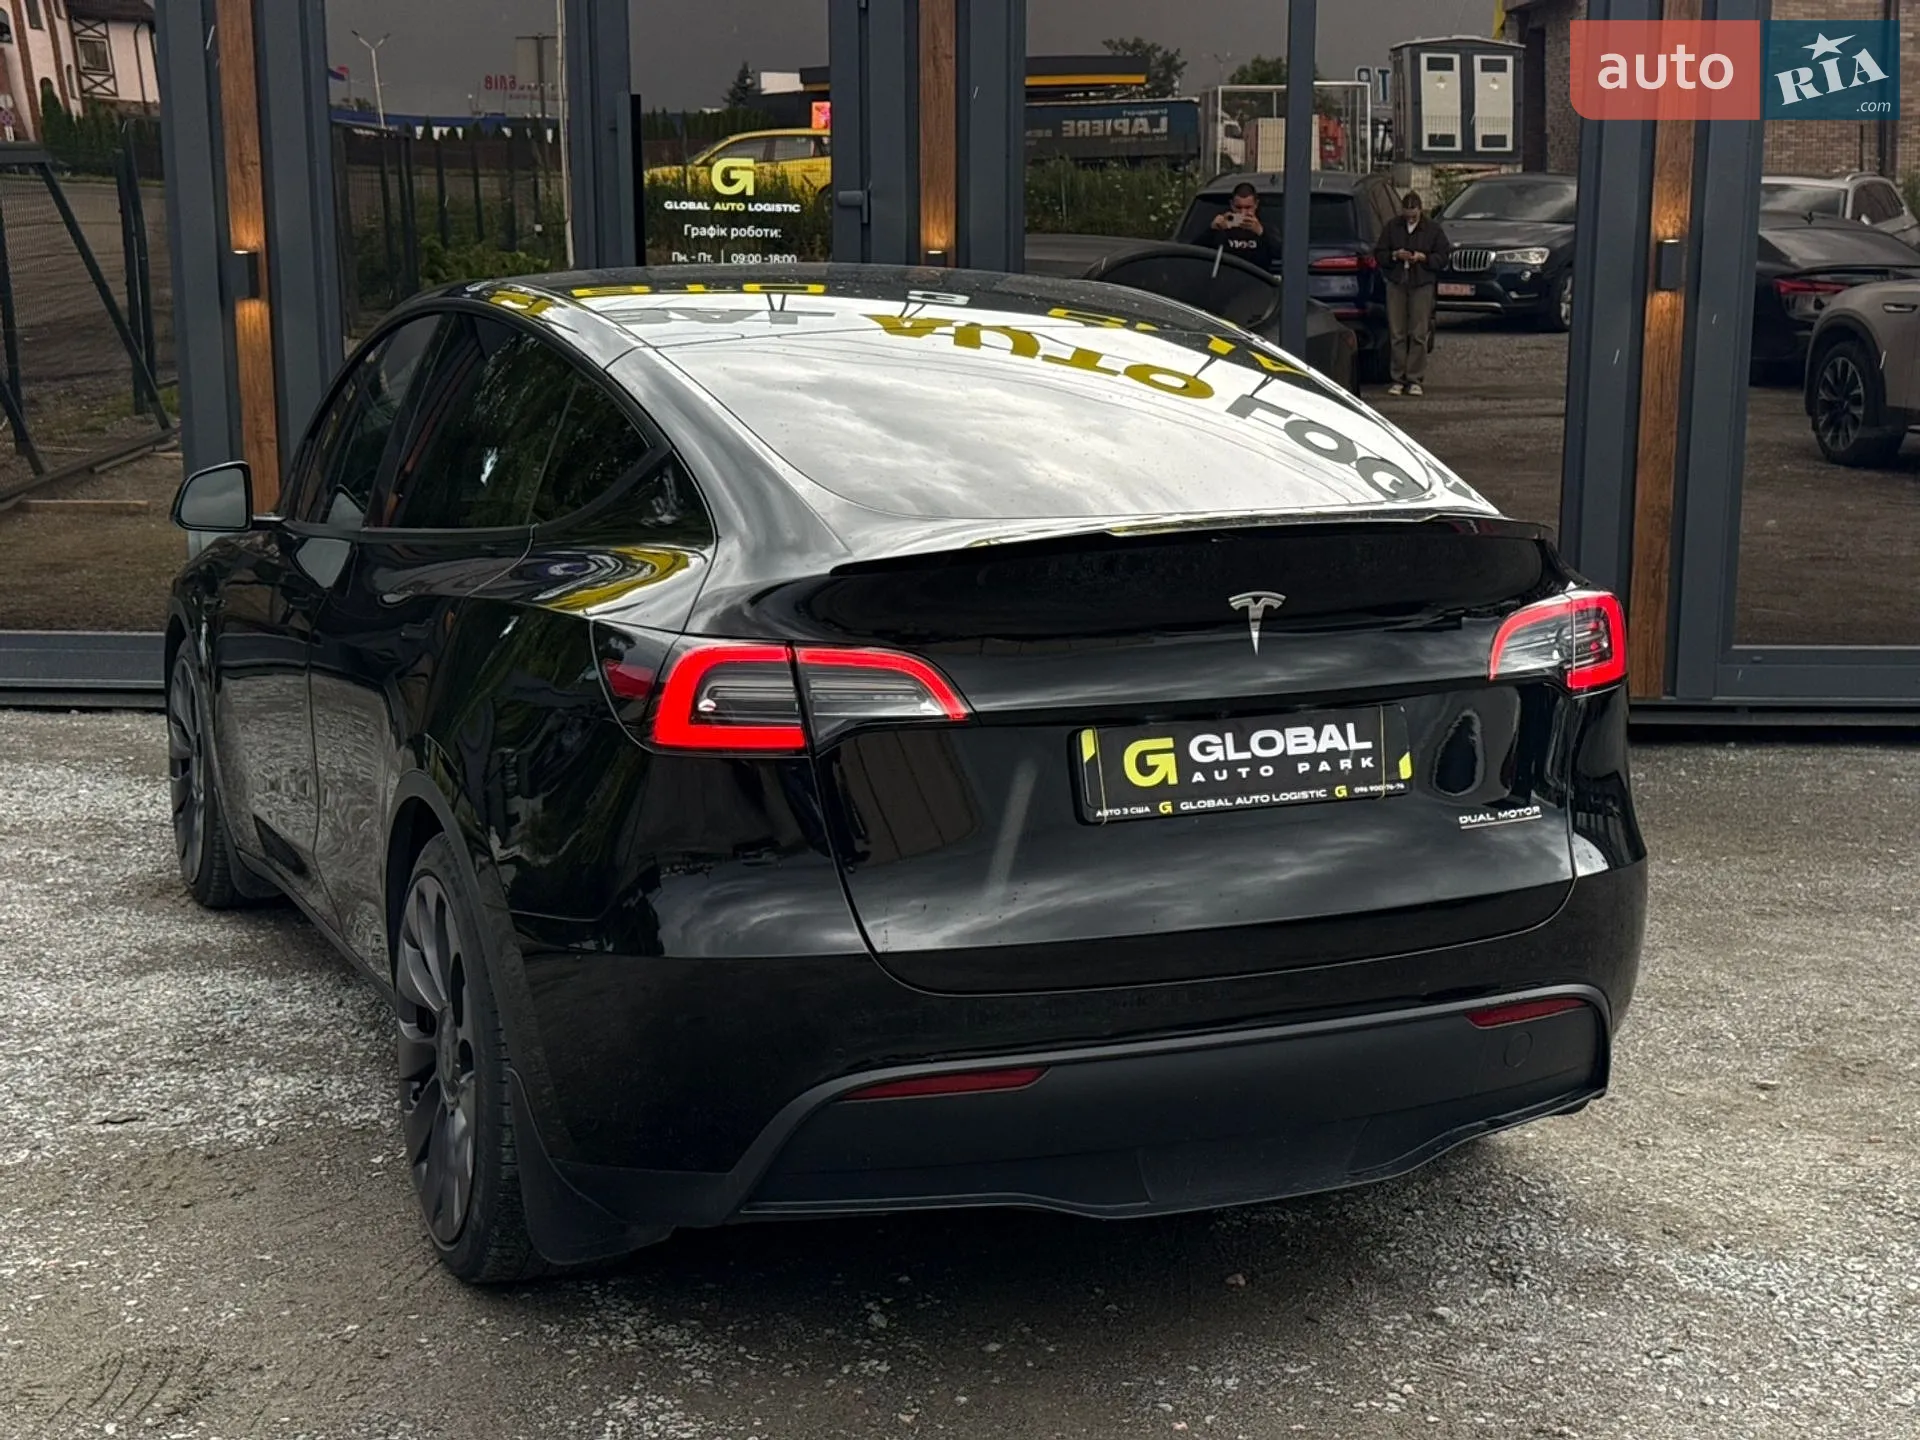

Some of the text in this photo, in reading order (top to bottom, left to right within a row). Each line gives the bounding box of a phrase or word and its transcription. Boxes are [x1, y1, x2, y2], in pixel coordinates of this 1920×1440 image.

[664, 201, 801, 213] GLOBAL AUTO LOGISTIC
[684, 224, 782, 239] Графік роботи:
[1188, 722, 1373, 763] GLOBAL
[1192, 756, 1375, 784] AUTO PARK
[1180, 796, 1233, 811] GLOBAL
[1234, 792, 1270, 805] AUTO
[1272, 788, 1328, 803] LOGISTIC
[1458, 805, 1540, 824] DUAL MOTOR
